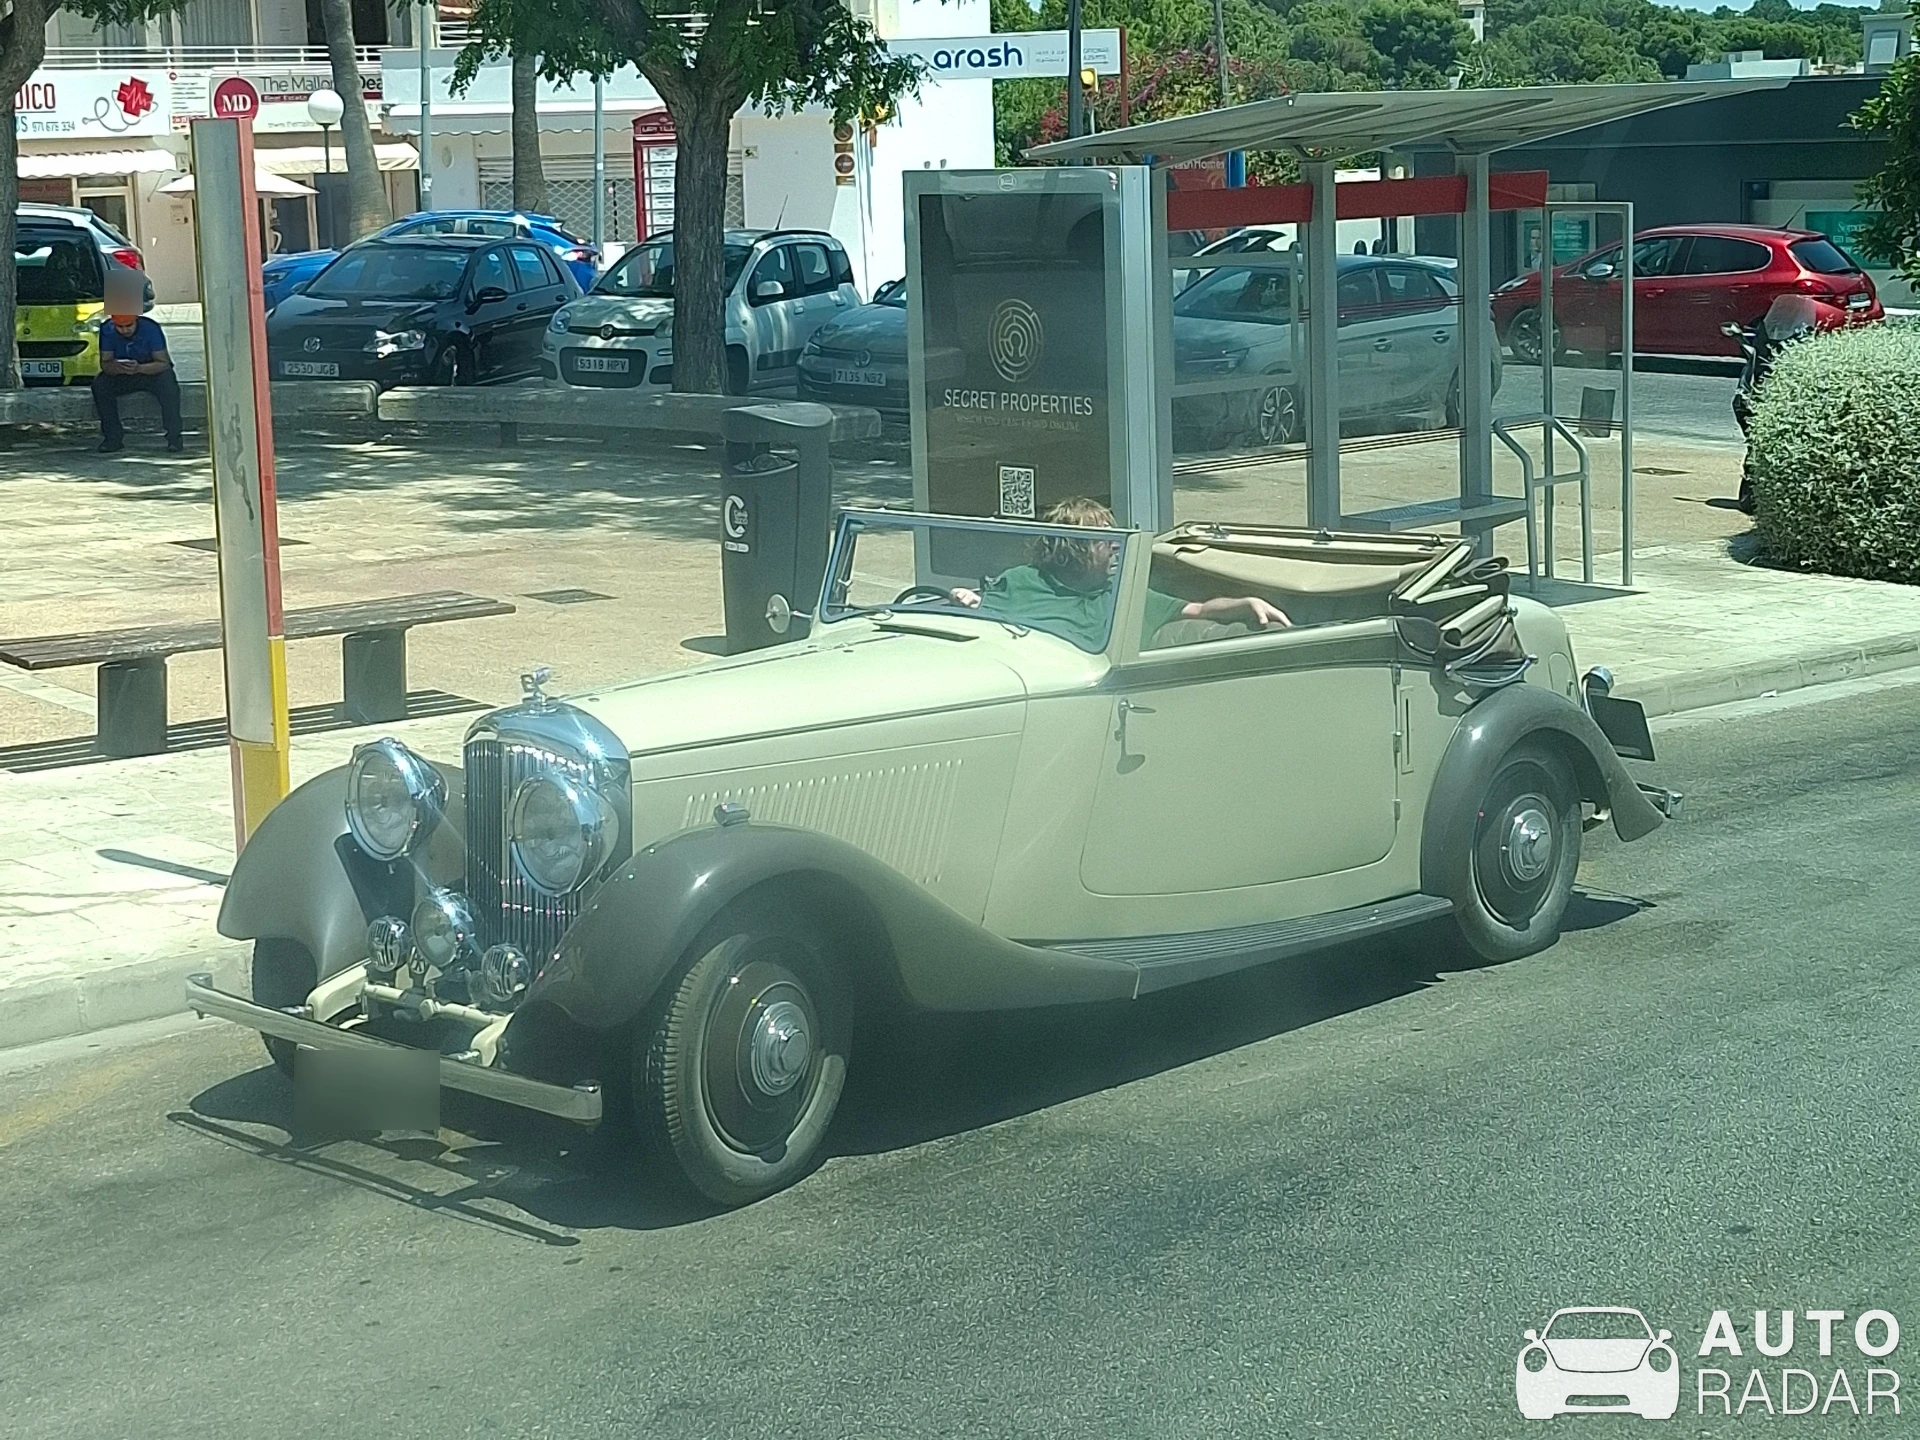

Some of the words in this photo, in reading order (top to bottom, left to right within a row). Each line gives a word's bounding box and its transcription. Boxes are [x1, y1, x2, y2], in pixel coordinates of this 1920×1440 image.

[933, 41, 1023, 69] arash
[261, 75, 289, 92] The
[222, 94, 251, 113] MD
[943, 388, 997, 410] SECRET
[1001, 392, 1093, 416] PROPERTIES
